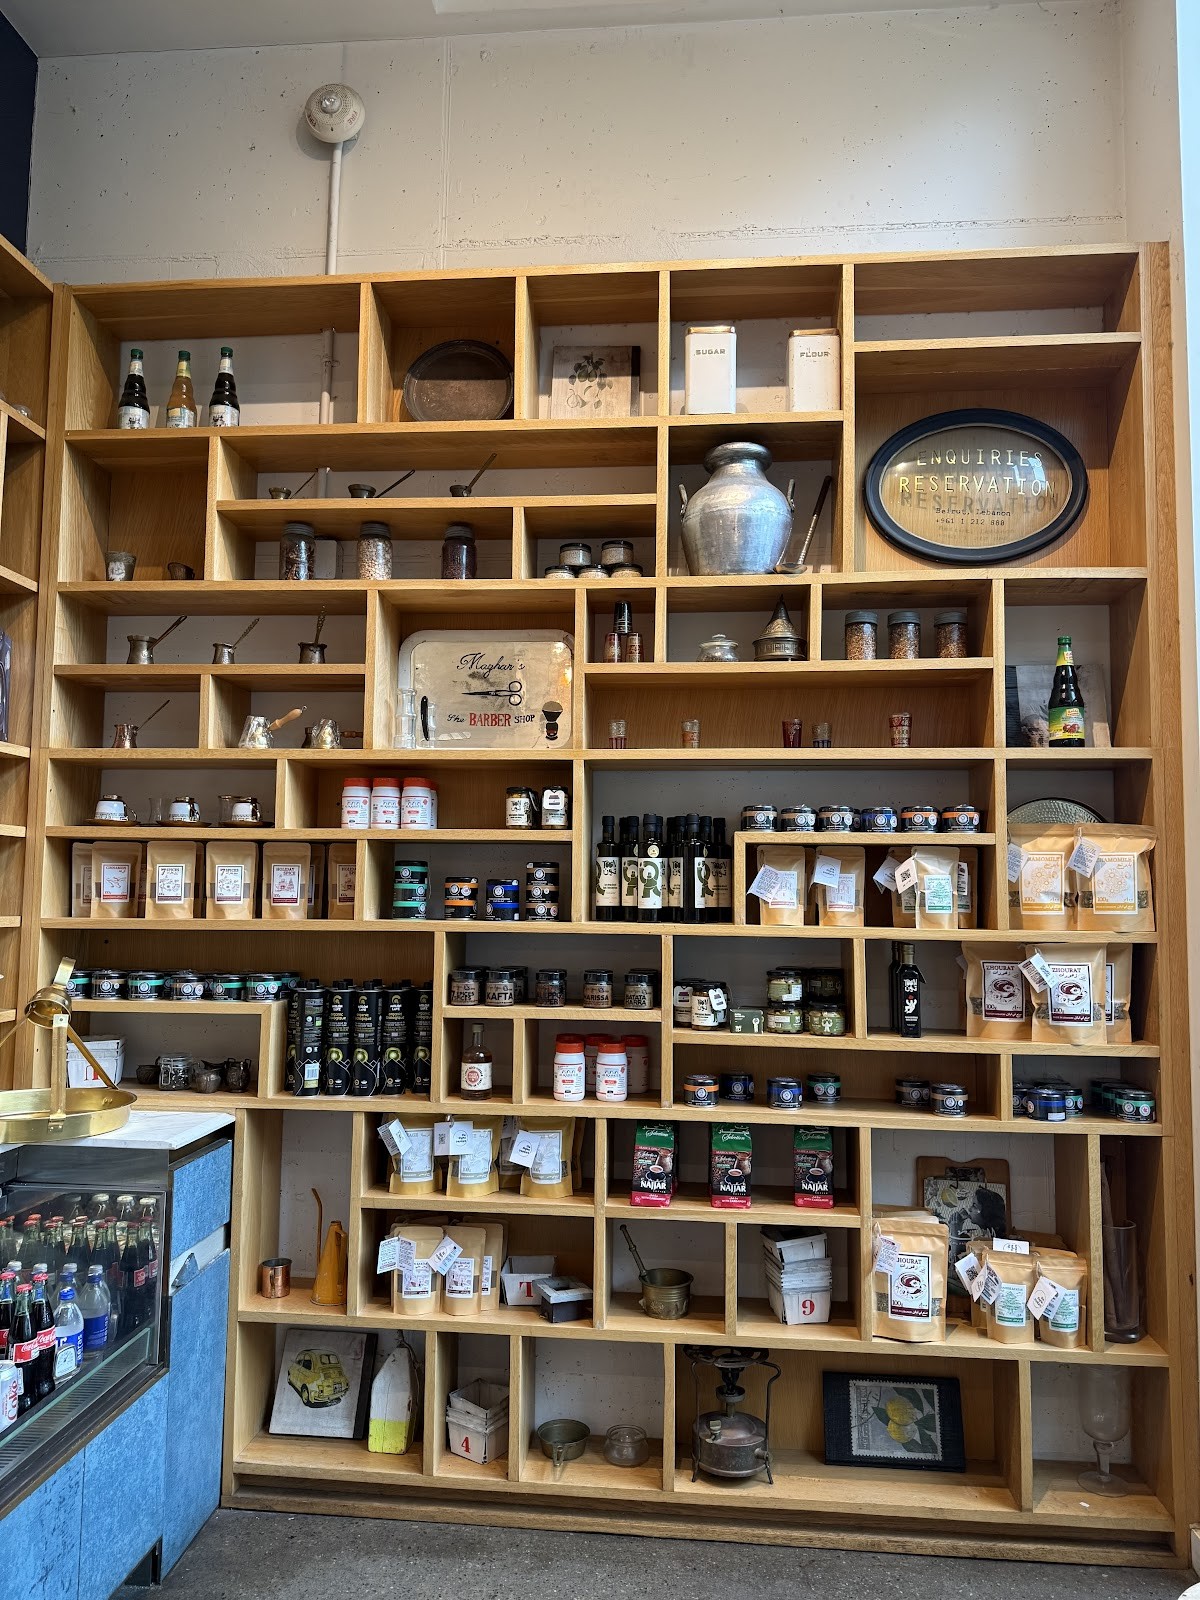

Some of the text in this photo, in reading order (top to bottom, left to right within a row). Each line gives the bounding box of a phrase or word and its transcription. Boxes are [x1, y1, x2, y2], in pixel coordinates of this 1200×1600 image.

[916, 448, 1043, 468] ENQUIRIES
[899, 475, 1056, 497] RESERVATION
[935, 507, 1011, 518] Beirut, Lebanon
[446, 712, 536, 727] The BARBER SHOP
[486, 992, 513, 1000] KAFTA
[721, 1134, 746, 1142] Selection
[640, 1181, 667, 1191] NAJJAR
[719, 1184, 747, 1193] NAJJAR
[801, 1183, 829, 1192] NAJJAR
[802, 1299, 815, 1316] 9
[7, 1380, 18, 1421] Coke
[460, 1436, 471, 1454] 4
